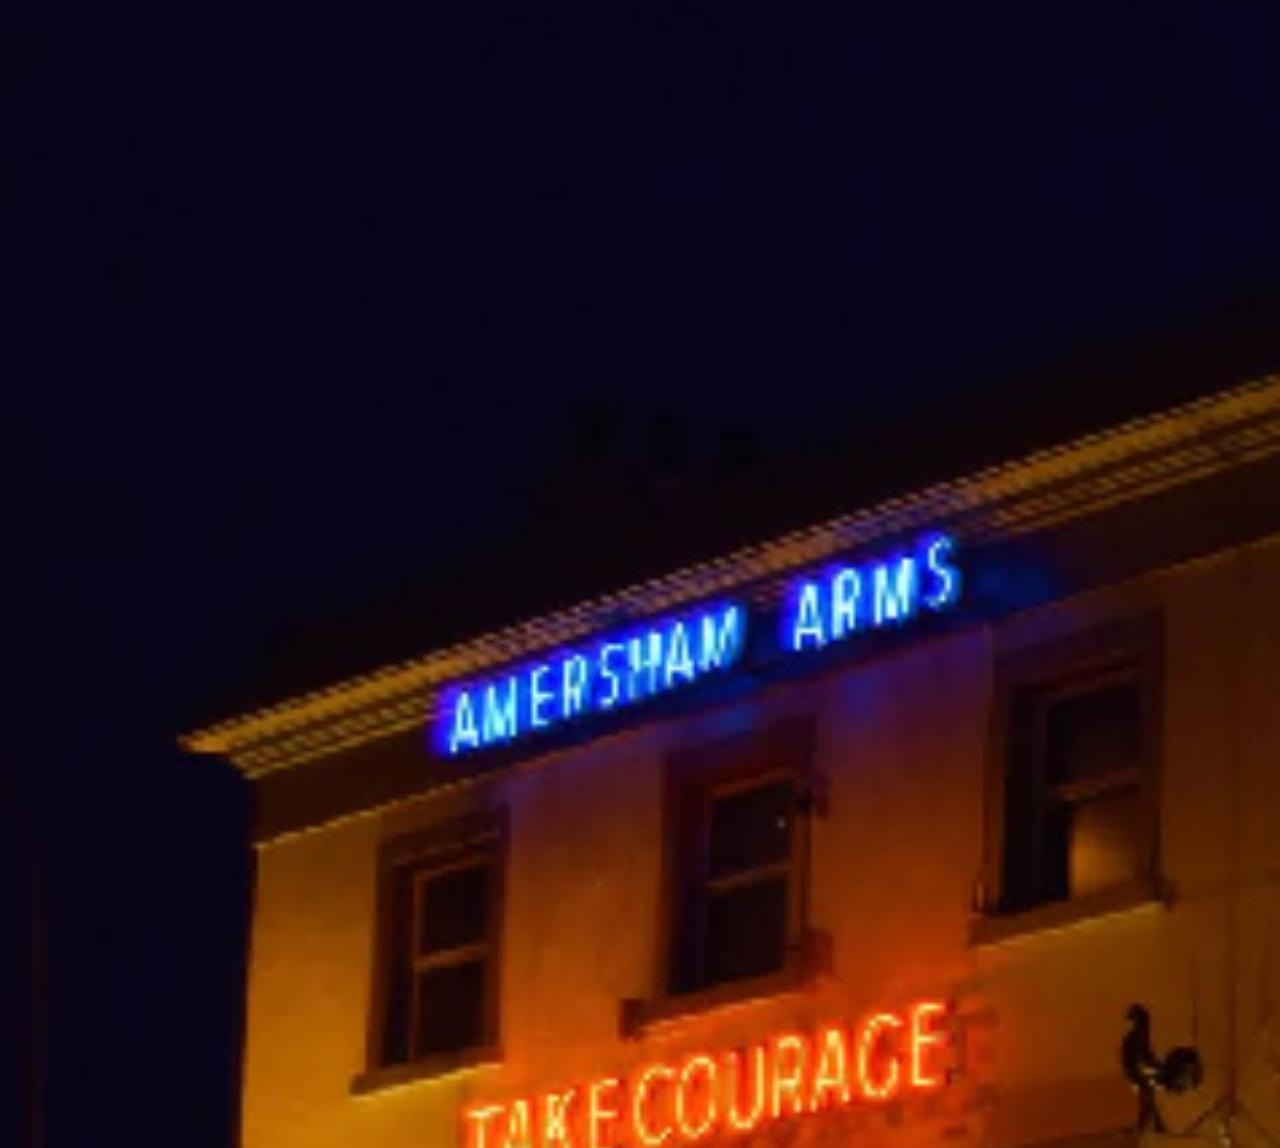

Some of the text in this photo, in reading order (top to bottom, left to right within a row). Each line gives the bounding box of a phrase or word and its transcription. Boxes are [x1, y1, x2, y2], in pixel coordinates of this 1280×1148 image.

[446, 536, 958, 754] AMERSHAM ARMS
[631, 1002, 946, 1147] COURAGE
